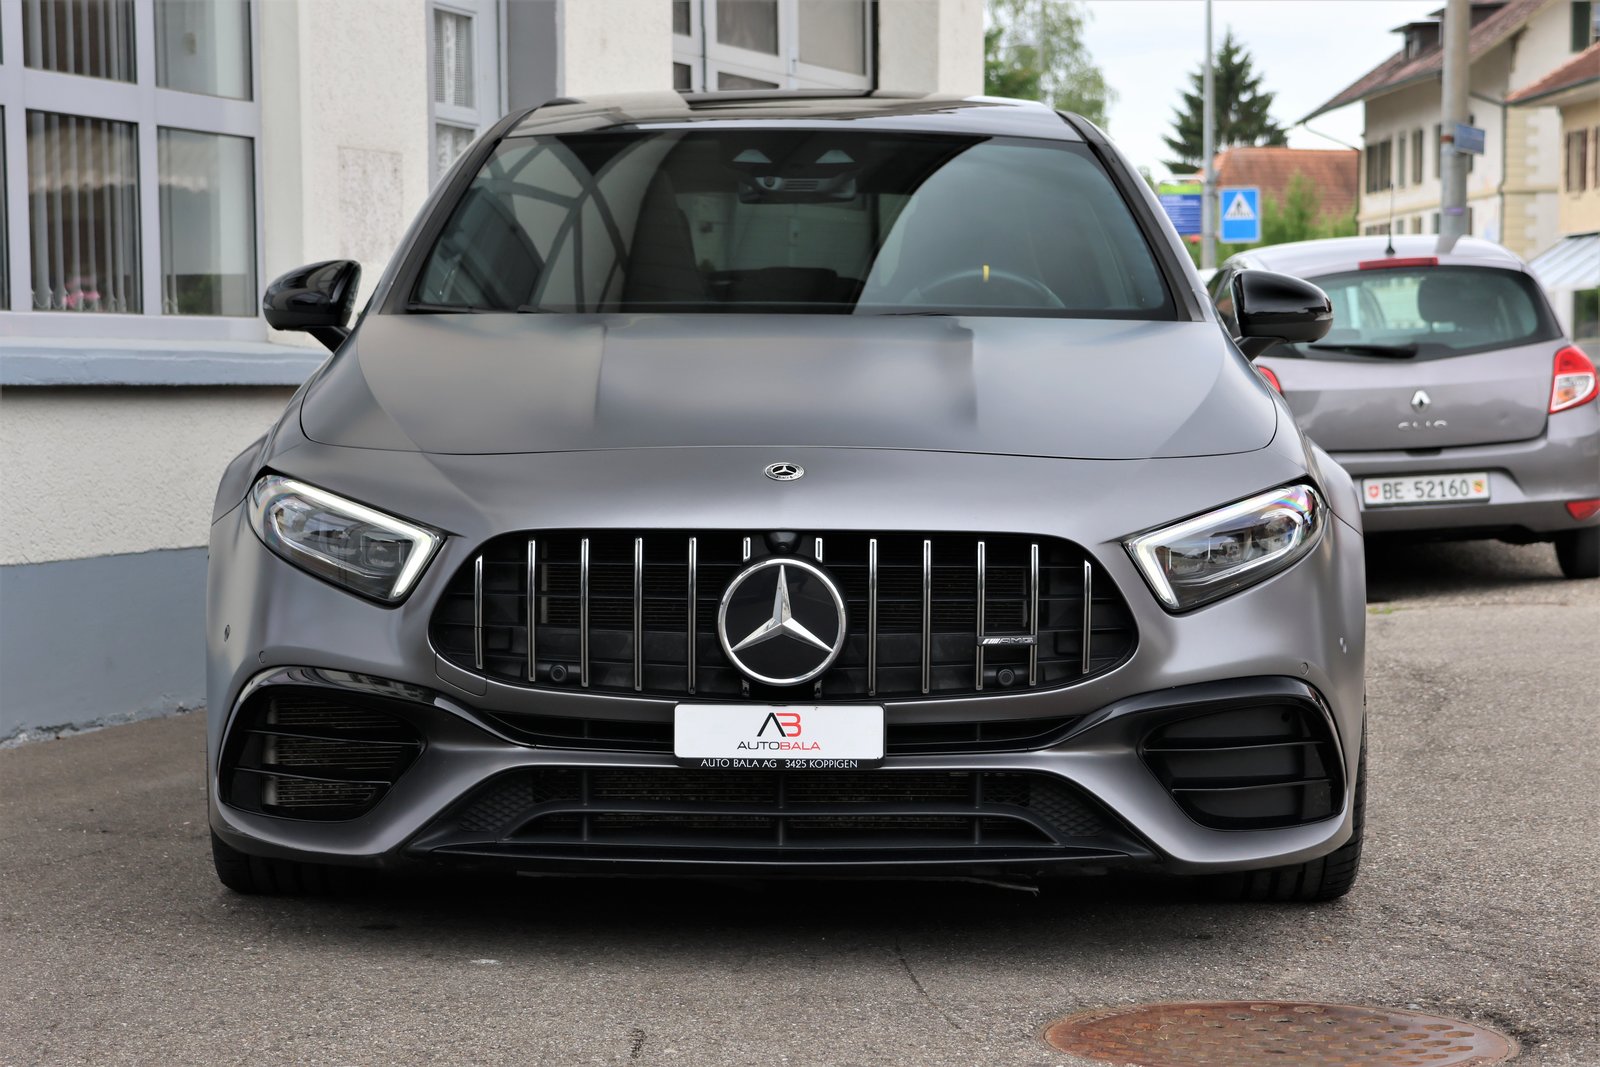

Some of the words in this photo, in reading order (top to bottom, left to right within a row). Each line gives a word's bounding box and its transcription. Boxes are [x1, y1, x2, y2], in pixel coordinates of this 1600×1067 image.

[1383, 482, 1404, 499] BE
[1414, 480, 1469, 498] 52160
[737, 741, 821, 751] AUTOBALA
[701, 758, 730, 768] AUTO
[733, 759, 760, 768] BALA
[763, 759, 778, 768] AG
[785, 759, 807, 768] 3425
[809, 759, 858, 769] KOPPIGEN
